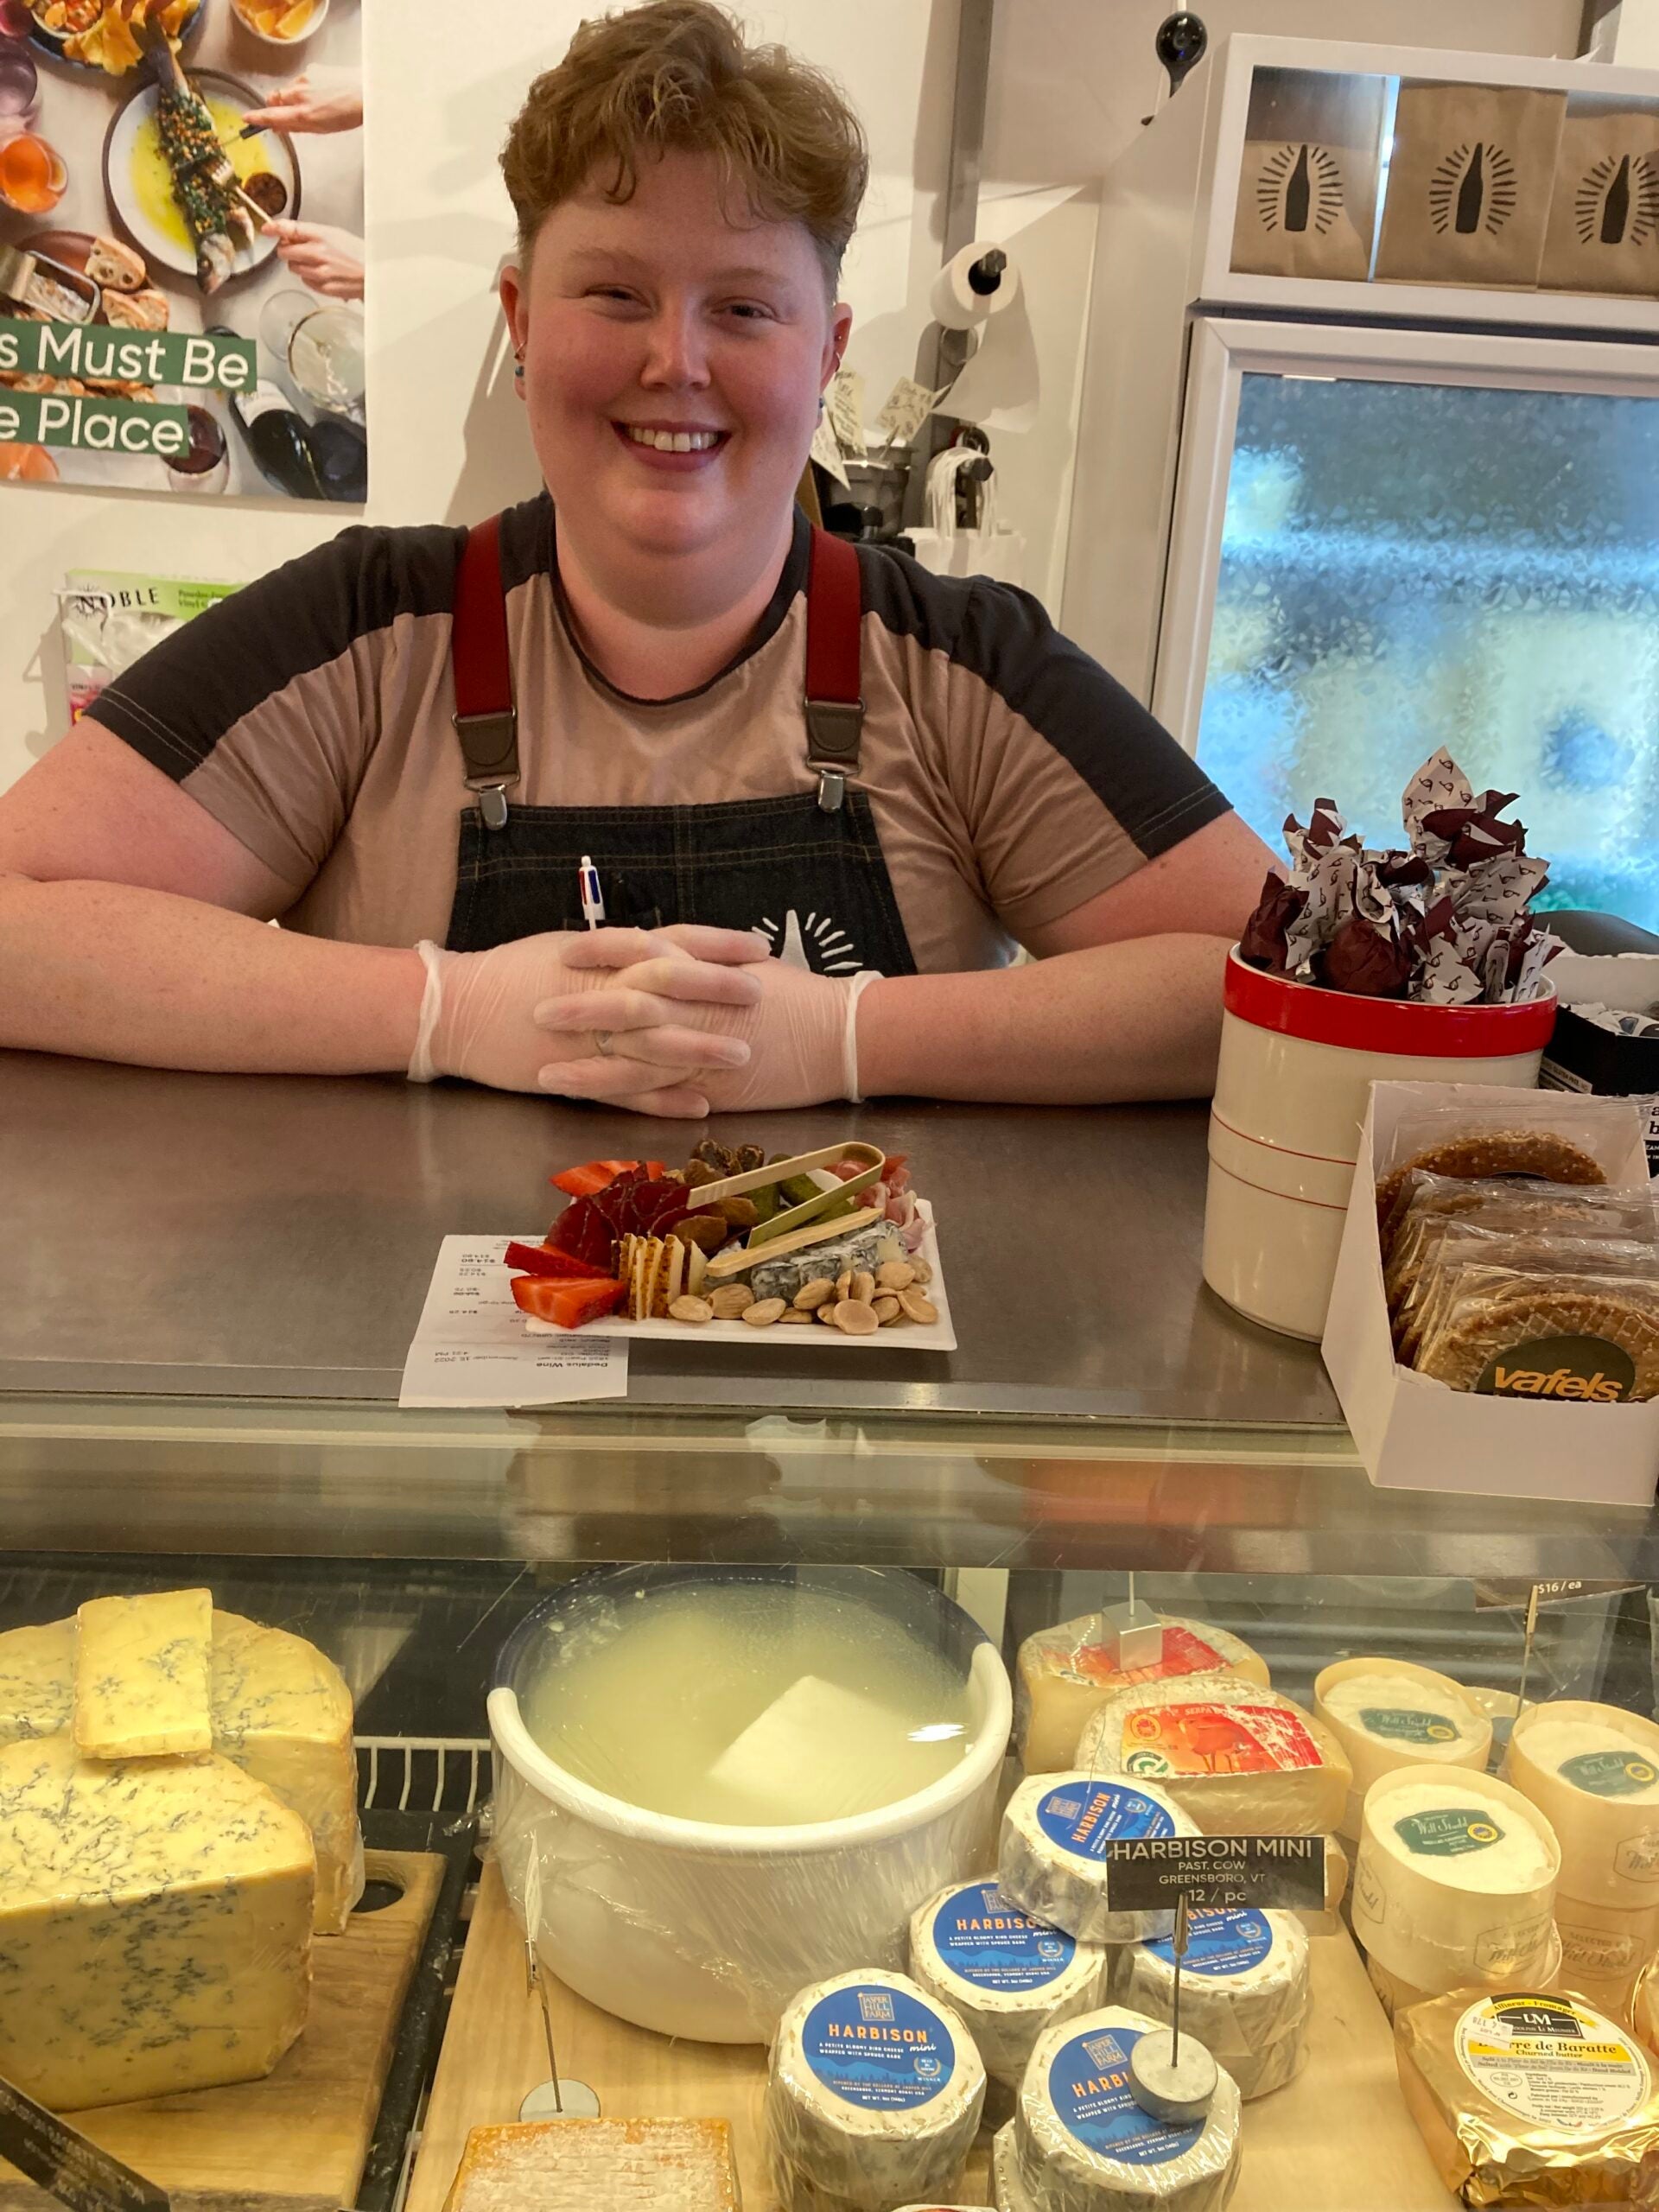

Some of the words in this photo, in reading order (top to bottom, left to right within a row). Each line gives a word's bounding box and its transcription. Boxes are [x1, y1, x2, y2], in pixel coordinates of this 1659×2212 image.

[38, 325, 166, 381] Must
[182, 338, 249, 388] Be
[37, 397, 184, 454] Place
[1495, 1366, 1623, 1402] vafels
[1567, 1580, 1582, 1590] ea
[1071, 1792, 1111, 1843] HARBISON
[1114, 1840, 1248, 1860] HARBISON
[1256, 1840, 1312, 1858] MINI
[1178, 1861, 1210, 1871] PAST.
[1213, 1861, 1246, 1871] COW
[1159, 1873, 1247, 1885] GREENSBORO,
[1251, 1873, 1266, 1883] VT
[1224, 1891, 1246, 1904] pc
[956, 1917, 1038, 1930] HARBISO
[829, 2024, 928, 2044] HARBISON
[909, 2043, 937, 2053] mini
[1516, 2049, 1554, 2057] Churned
[1535, 2041, 1553, 2051] de
[1557, 2042, 1618, 2055] Baratte
[1072, 2071, 1130, 2098] HARBI
